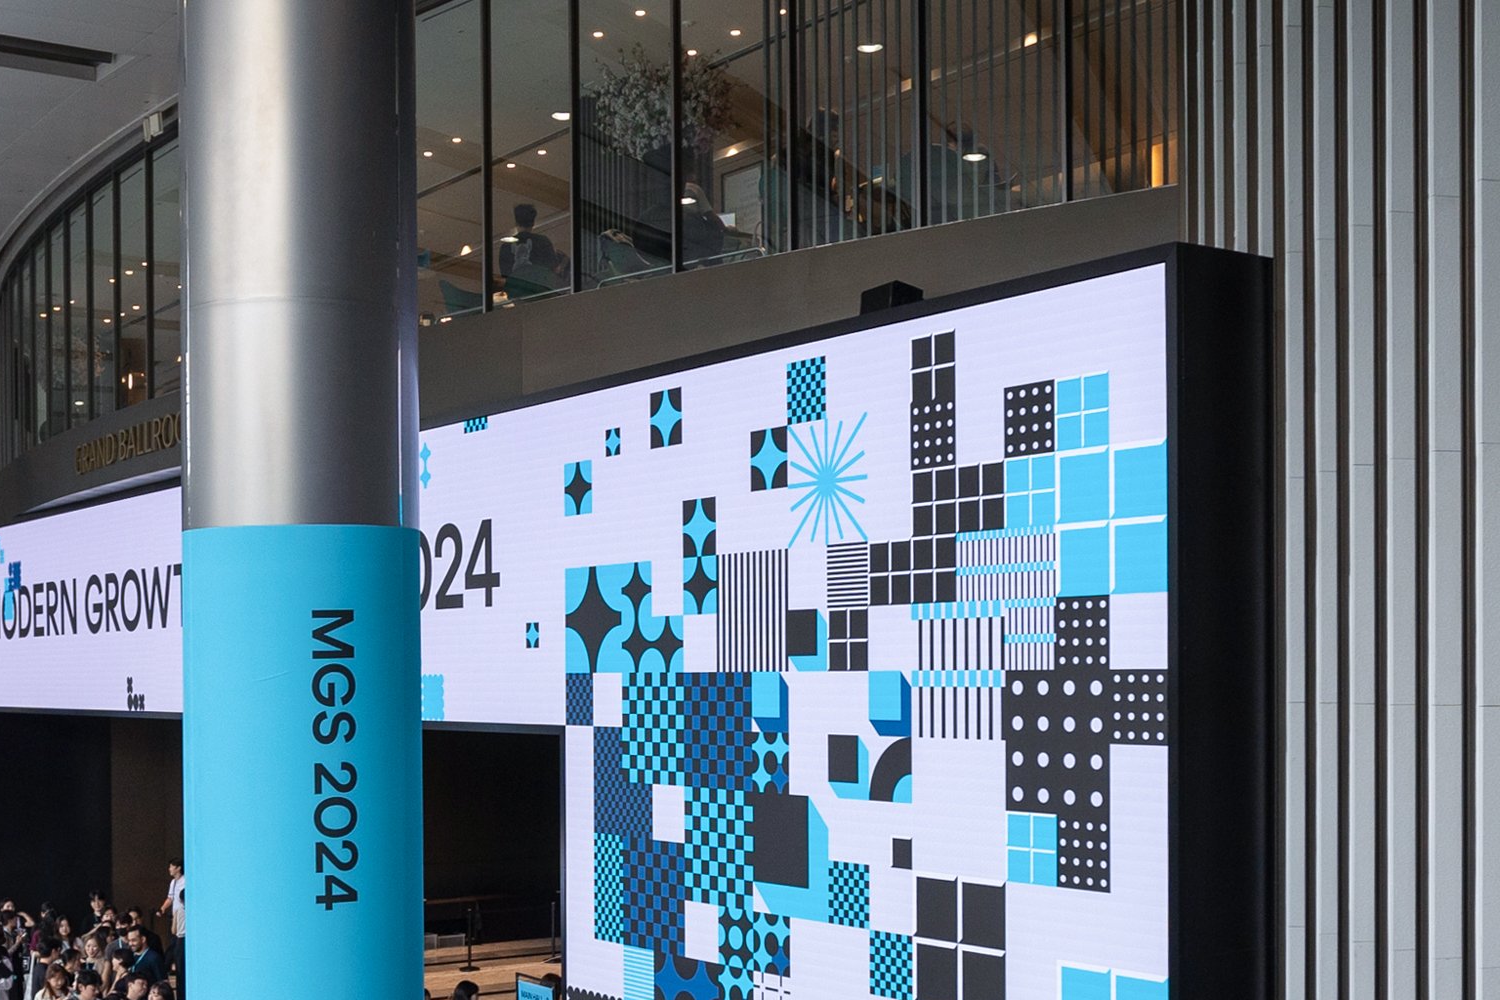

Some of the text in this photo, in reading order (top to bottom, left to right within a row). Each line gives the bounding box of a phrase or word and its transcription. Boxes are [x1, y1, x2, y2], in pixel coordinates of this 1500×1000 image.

[76, 411, 181, 475] GRAND BALLROO
[85, 563, 183, 634] GROW
[419, 518, 501, 611] 24
[311, 609, 359, 911] MGS 2024
